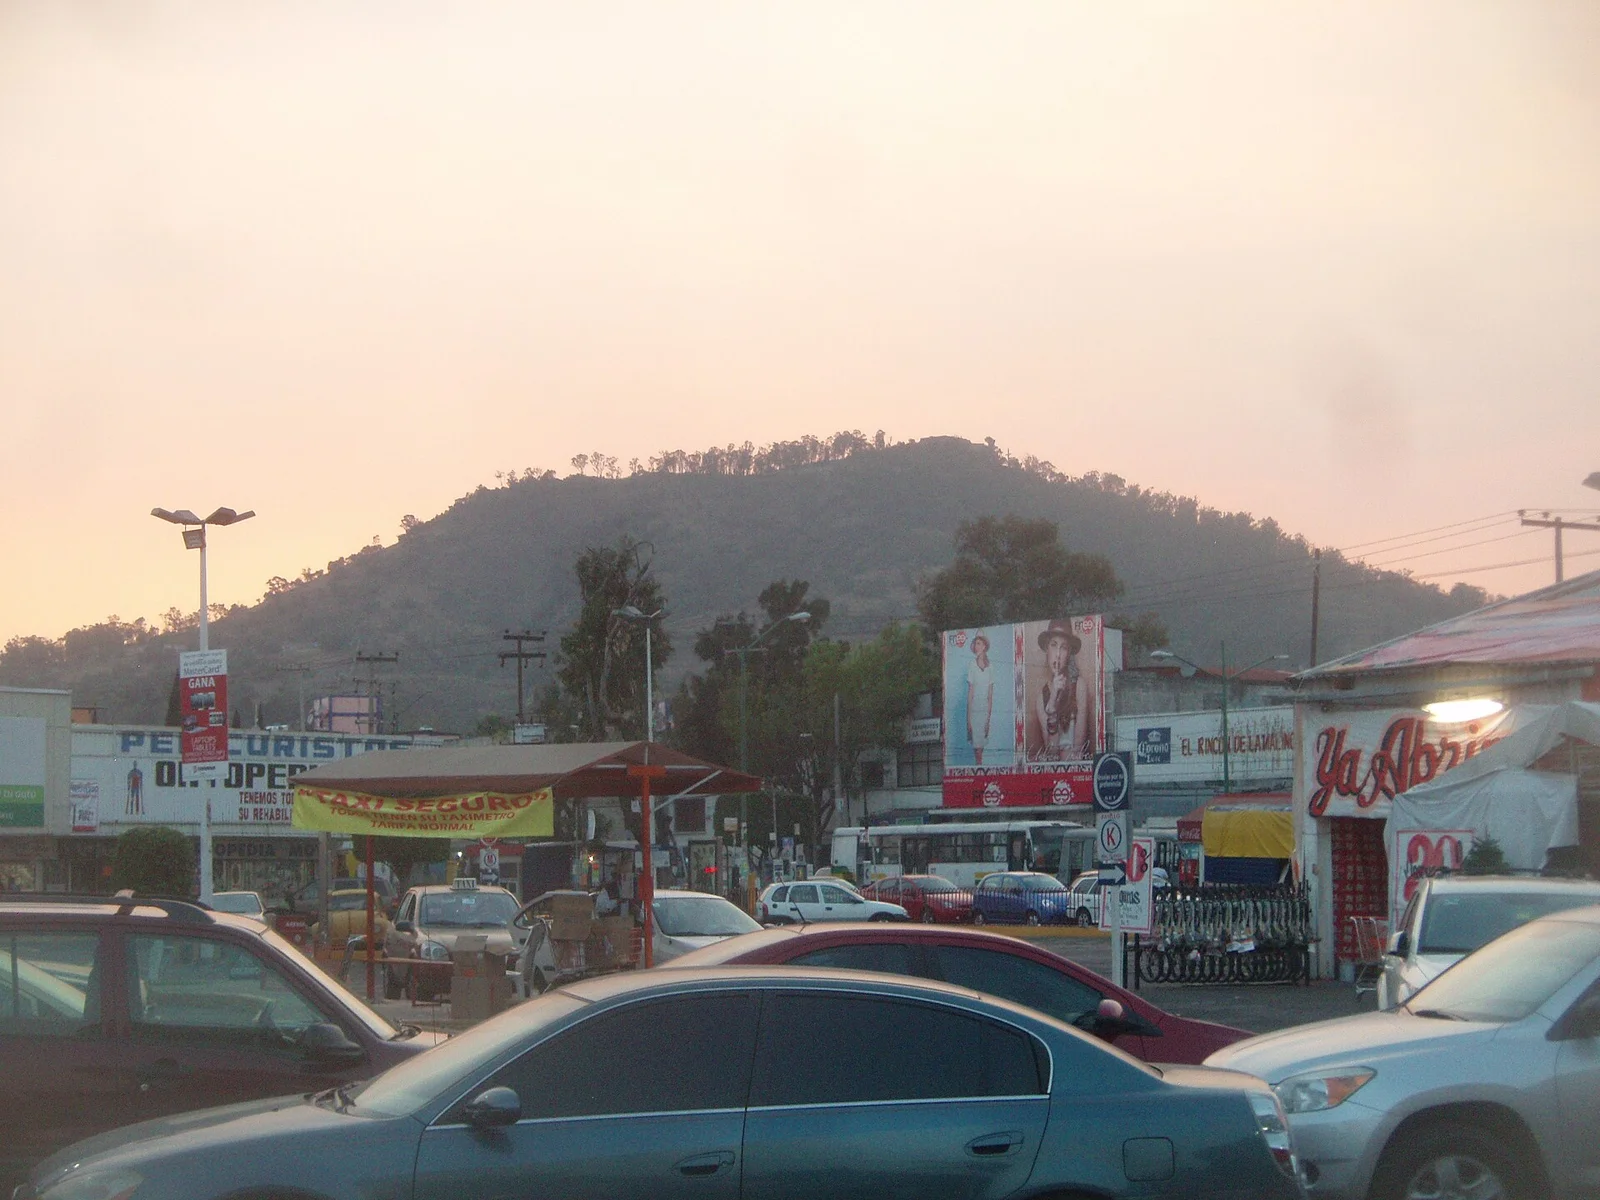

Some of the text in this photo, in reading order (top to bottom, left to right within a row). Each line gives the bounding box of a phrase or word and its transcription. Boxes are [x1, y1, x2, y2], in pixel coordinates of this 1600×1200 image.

[188, 676, 216, 689] GANA
[1138, 741, 1169, 757] Corona
[1357, 717, 1503, 808] Abri
[1309, 726, 1362, 818] Ya
[239, 792, 277, 804] TENEMOS
[239, 808, 249, 820] SU
[440, 812, 516, 821] TAXIMETRO
[371, 819, 476, 831] TARIFA NORMAL
[1106, 827, 1116, 846] K
